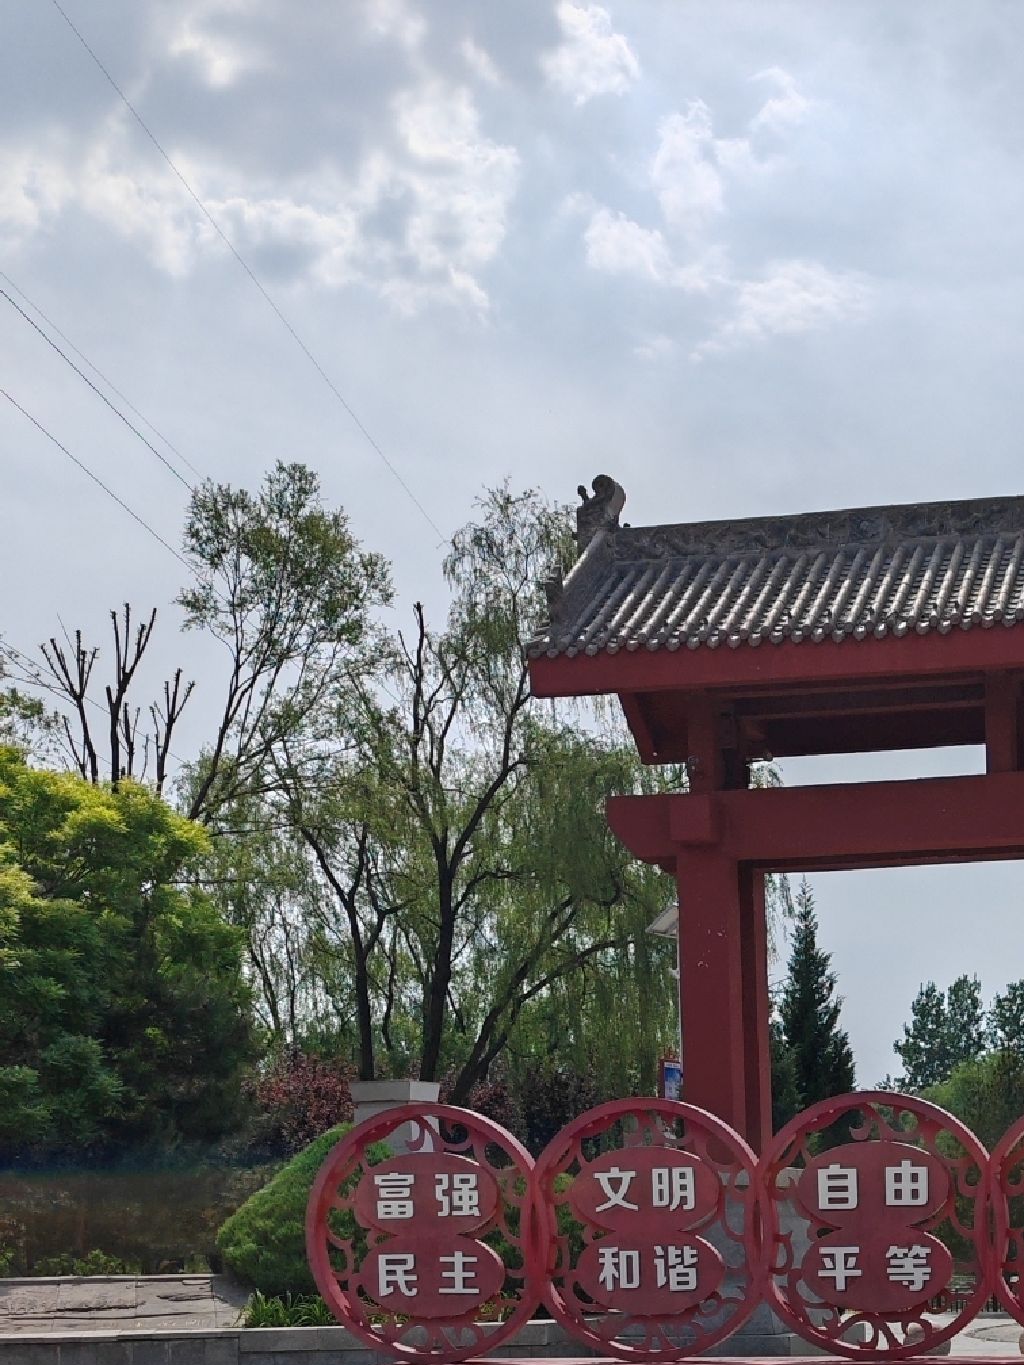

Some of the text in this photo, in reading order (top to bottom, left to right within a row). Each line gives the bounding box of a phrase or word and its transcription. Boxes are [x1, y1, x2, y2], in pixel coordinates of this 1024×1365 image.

[374, 1173, 479, 1219] 富强
[595, 1167, 694, 1211] 文明
[818, 1161, 928, 1209] 自由
[379, 1251, 479, 1296] 民主
[599, 1246, 696, 1290] 和谐
[818, 1246, 931, 1290] 平等
